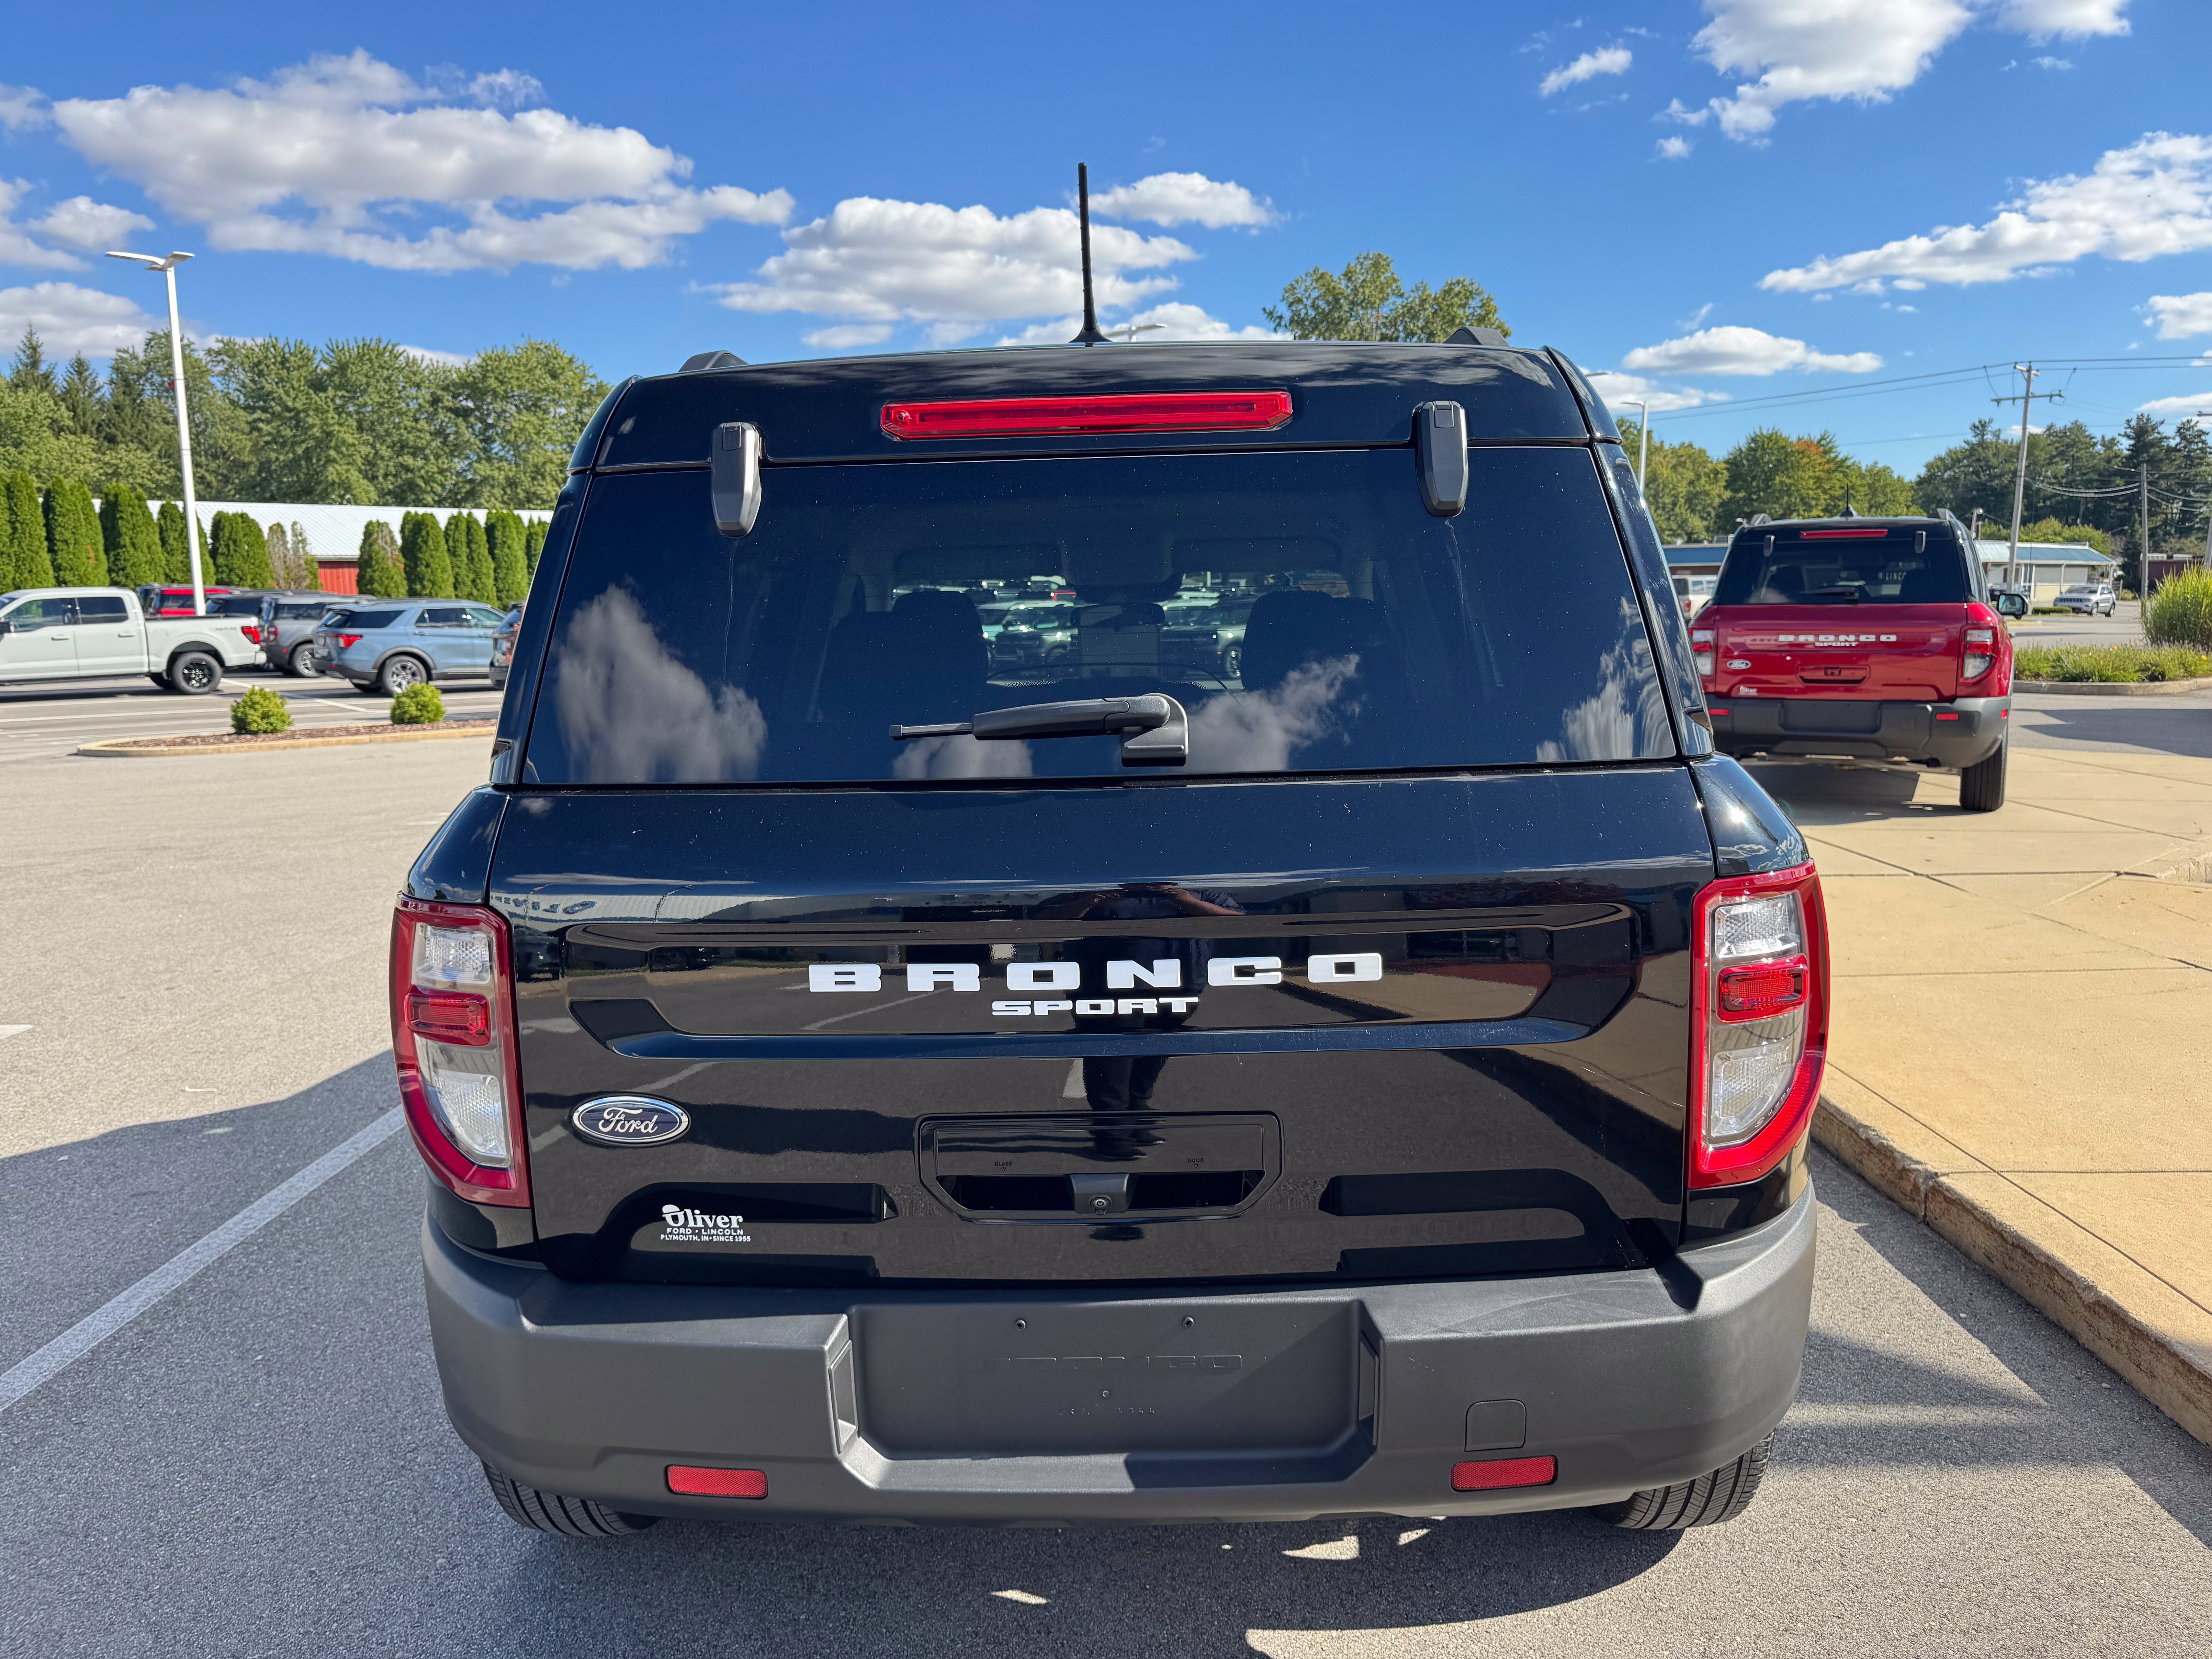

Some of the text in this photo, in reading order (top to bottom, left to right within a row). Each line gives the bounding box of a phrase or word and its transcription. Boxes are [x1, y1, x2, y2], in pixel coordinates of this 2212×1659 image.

[809, 953, 1382, 992] BRONCO
[992, 997, 1199, 1015] SPORT
[598, 1107, 659, 1133] Ford
[662, 1204, 744, 1228] Oliver
[660, 1234, 700, 1242] PLYMOUTH,
